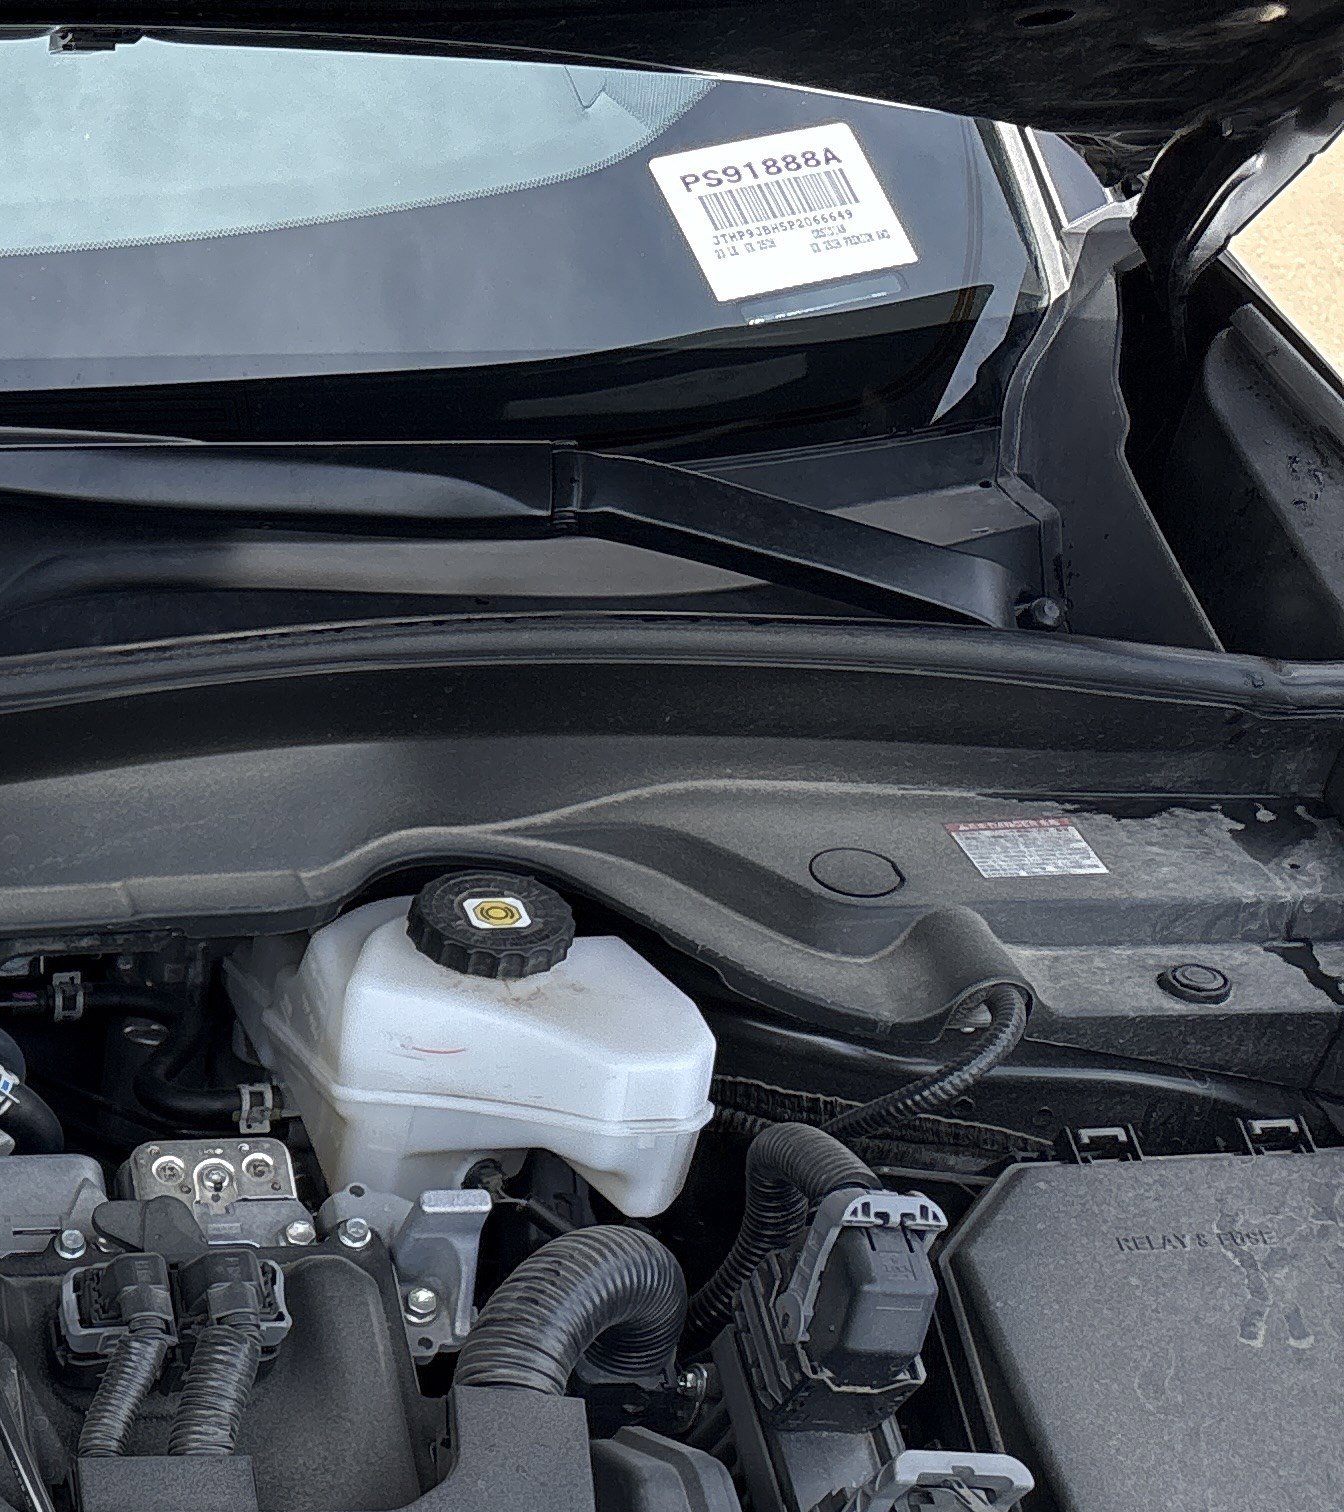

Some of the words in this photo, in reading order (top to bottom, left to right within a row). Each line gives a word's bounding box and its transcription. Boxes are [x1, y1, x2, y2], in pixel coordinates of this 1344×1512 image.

[680, 147, 842, 193] PS91888A
[1115, 1233, 1189, 1251] RELAY
[1196, 1233, 1209, 1247] &
[1216, 1229, 1277, 1247] FUSE
